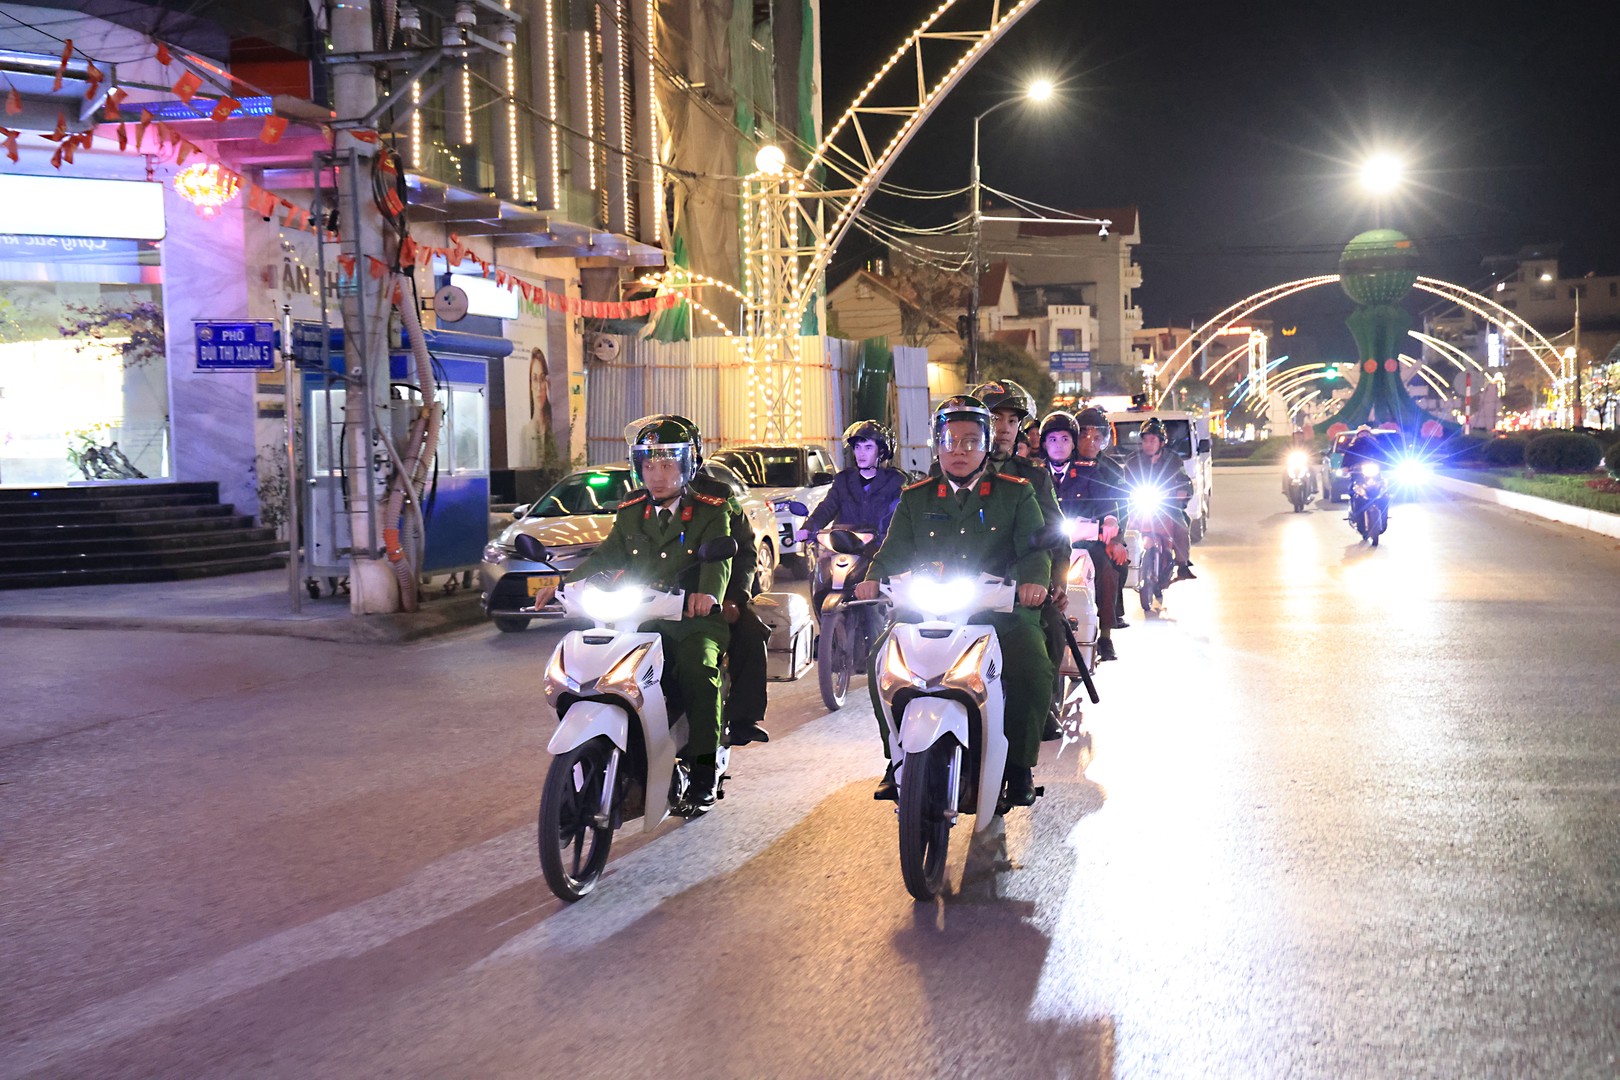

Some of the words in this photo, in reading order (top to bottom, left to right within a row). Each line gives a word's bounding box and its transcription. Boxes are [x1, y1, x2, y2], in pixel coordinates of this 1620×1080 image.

[222, 327, 245, 341] PHỐ
[200, 342, 217, 361] BÙI
[219, 345, 234, 363] THỊ
[235, 342, 261, 361] XUÂN
[262, 345, 269, 361] 5
